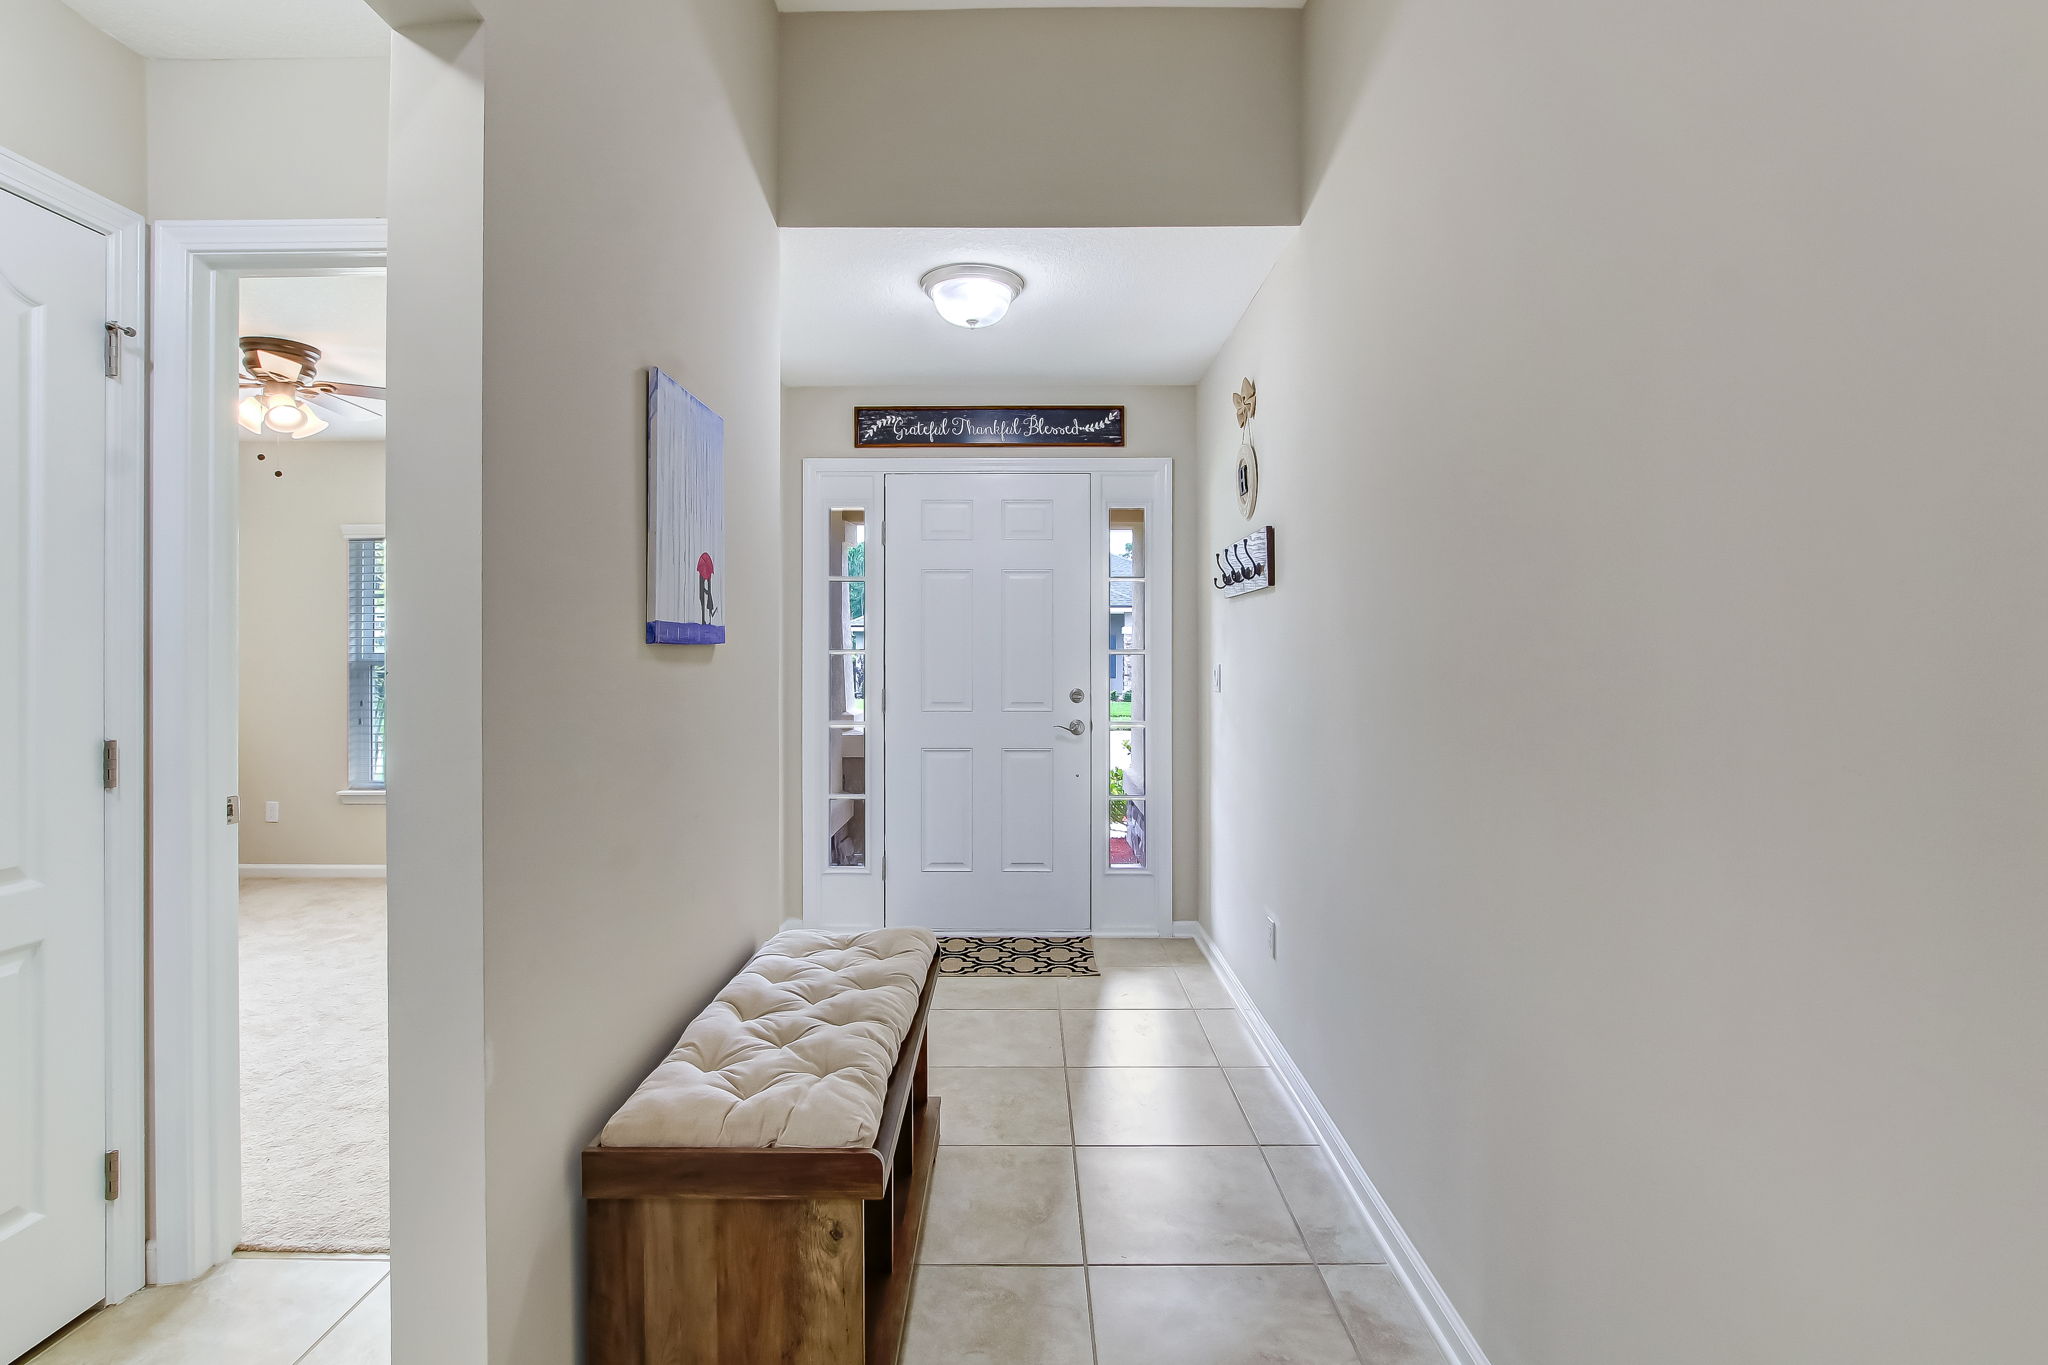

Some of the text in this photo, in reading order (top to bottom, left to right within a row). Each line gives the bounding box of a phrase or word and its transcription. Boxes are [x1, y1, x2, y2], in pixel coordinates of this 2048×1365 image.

[893, 415, 1080, 442] Grateful Thankful Blessed
